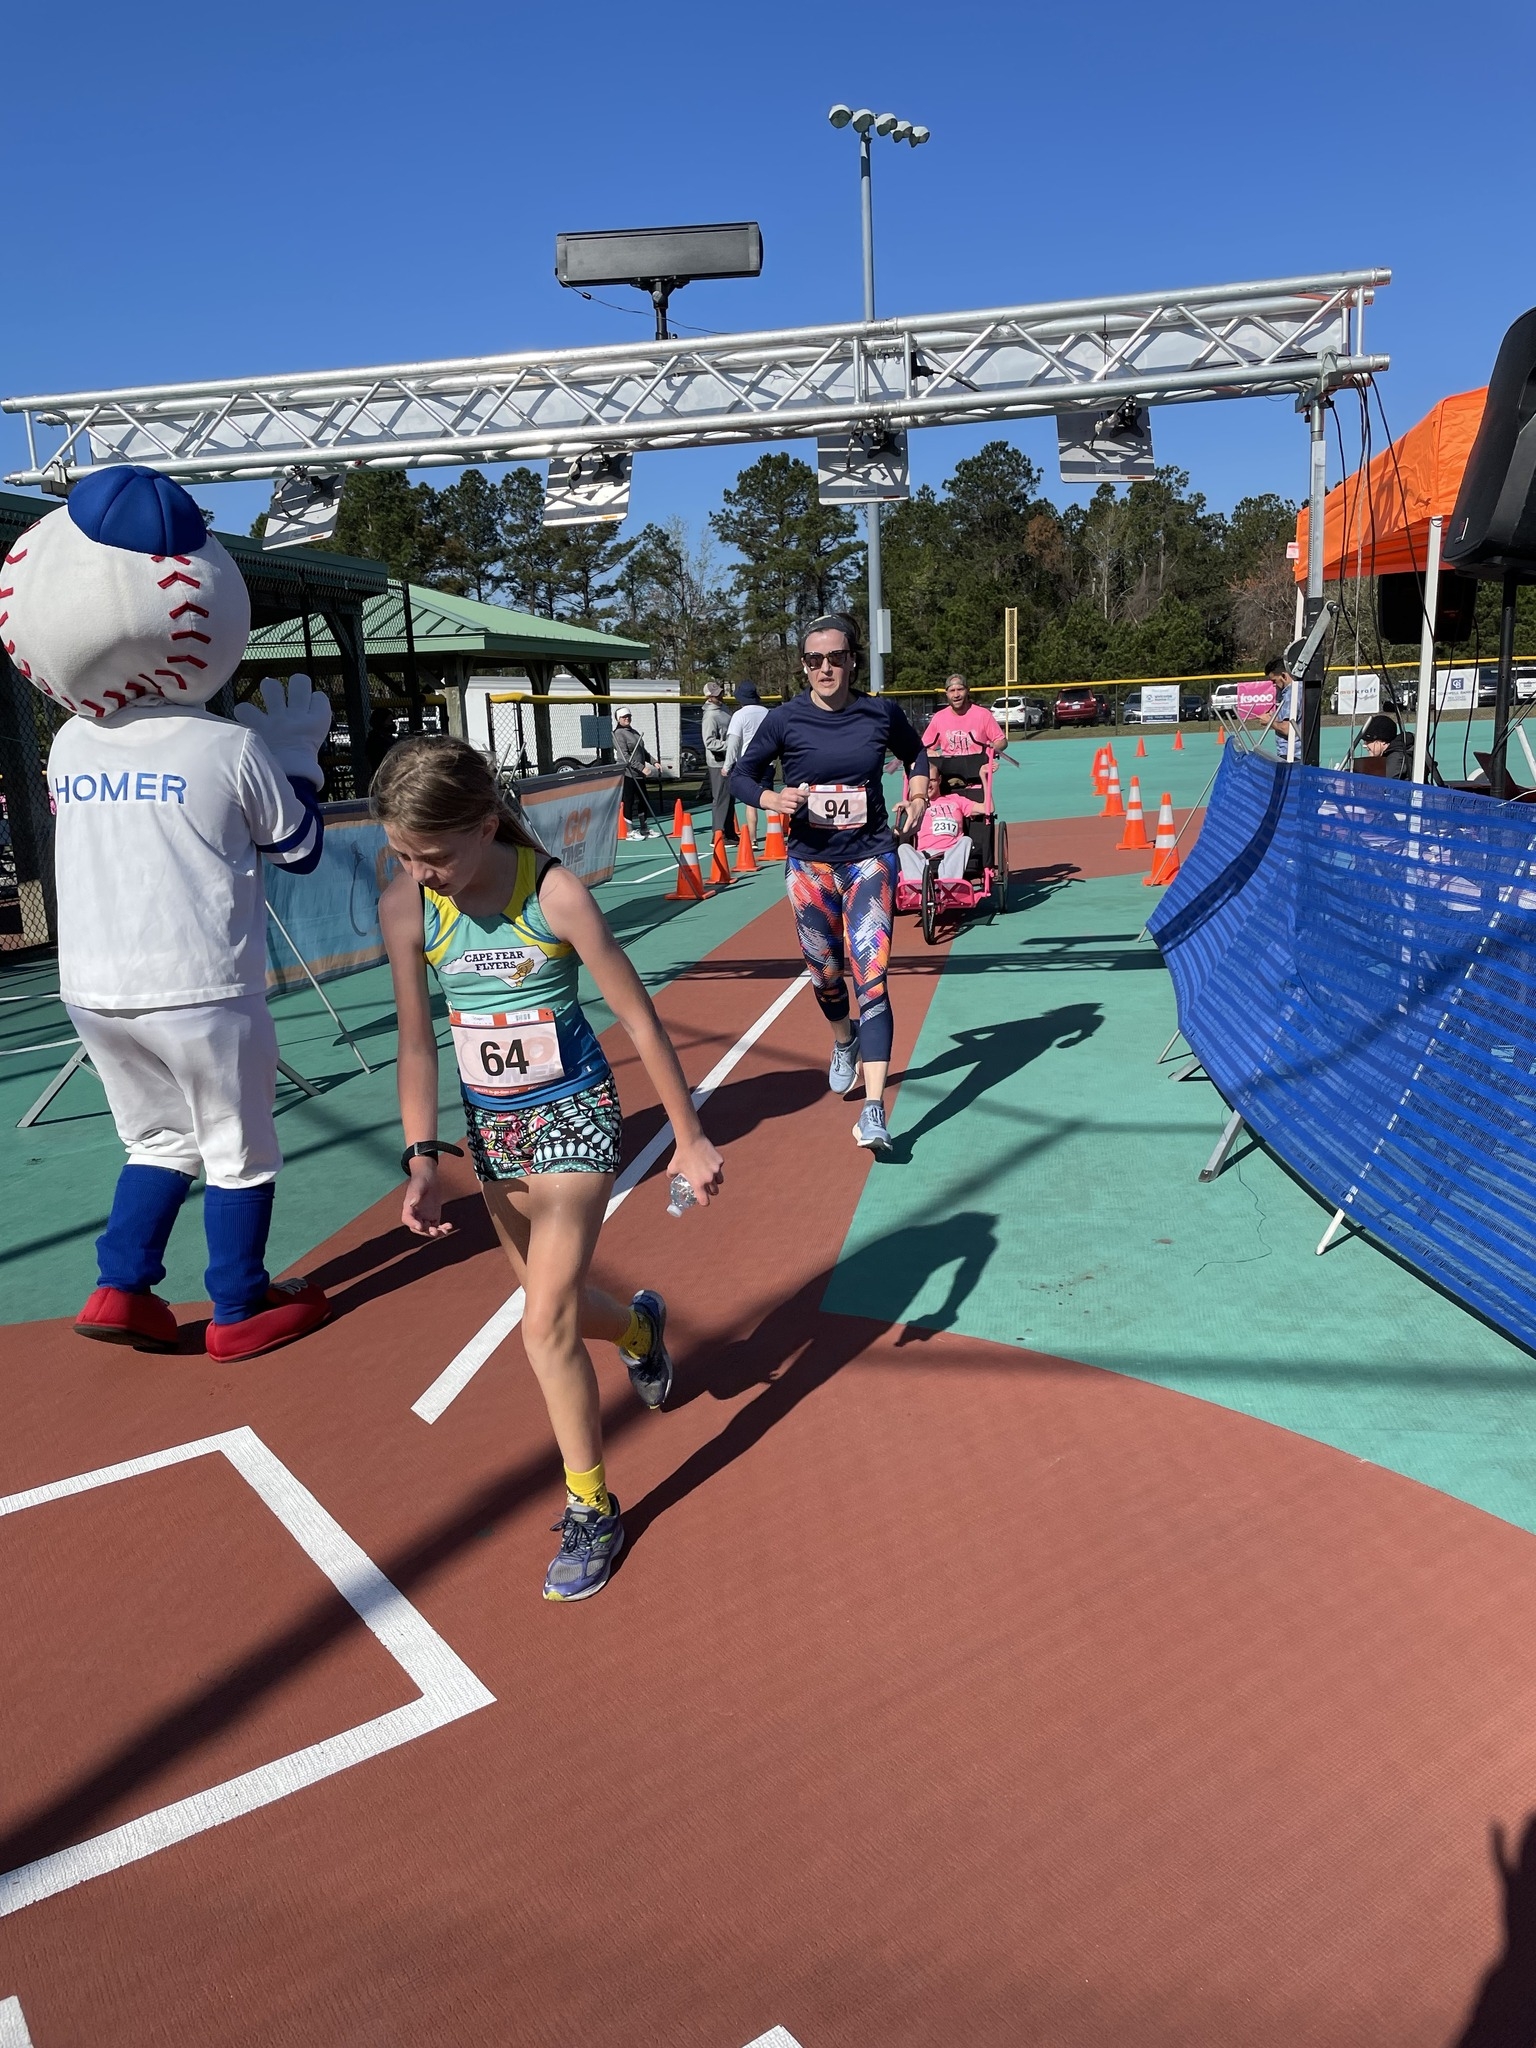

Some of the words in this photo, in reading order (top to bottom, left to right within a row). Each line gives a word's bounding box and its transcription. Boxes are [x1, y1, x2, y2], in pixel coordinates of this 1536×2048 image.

[55, 772, 187, 804] HOMER
[824, 799, 850, 819] 94
[564, 807, 591, 846] GO
[934, 822, 957, 833] 2317
[464, 953, 494, 964] CAPE
[495, 951, 525, 960] FEAR
[475, 961, 516, 971] FLYERS
[480, 1038, 529, 1076] 64
